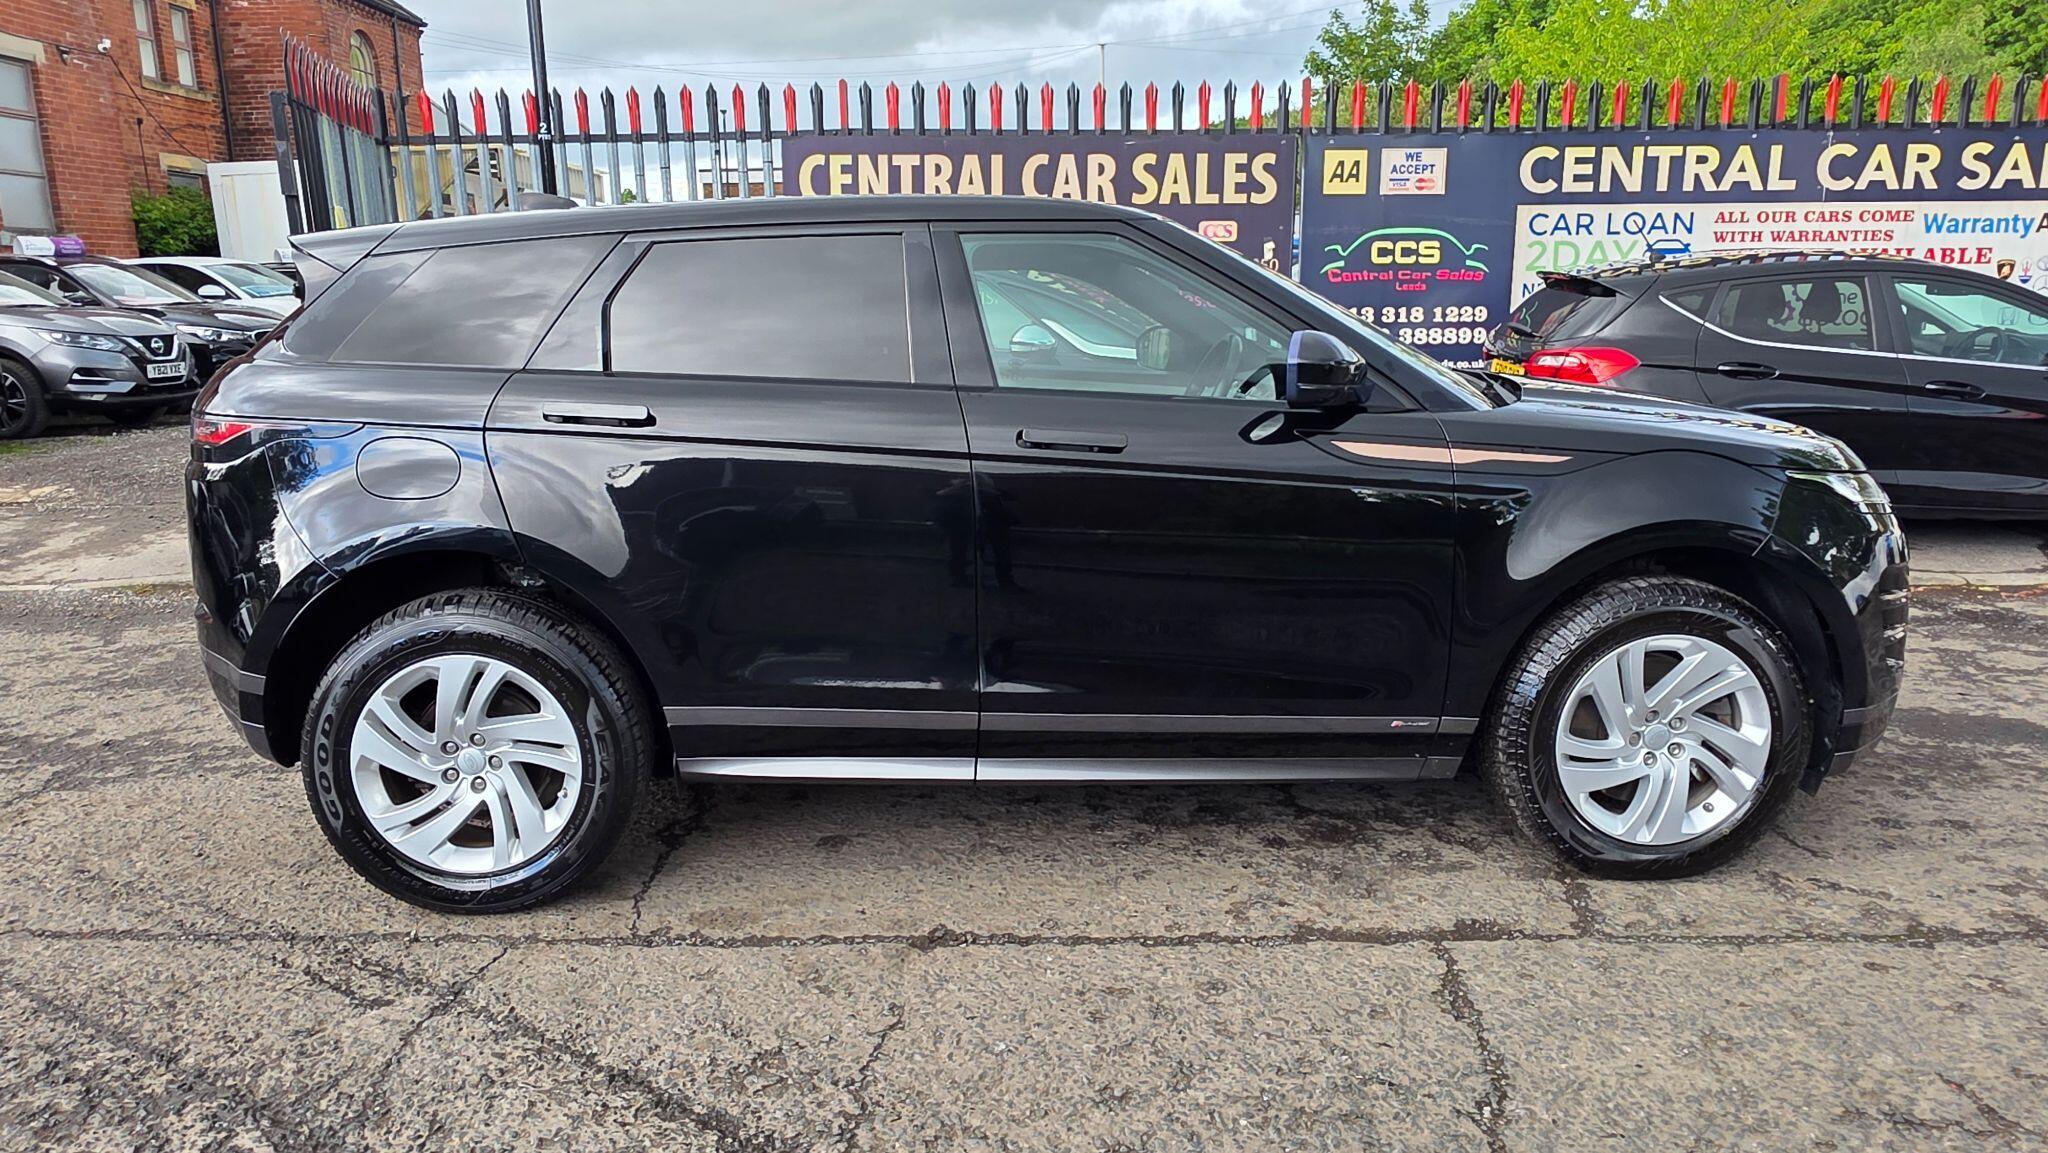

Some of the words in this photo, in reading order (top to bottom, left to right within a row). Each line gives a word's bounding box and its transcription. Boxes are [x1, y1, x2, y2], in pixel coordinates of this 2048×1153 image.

[540, 122, 548, 134] 2
[1405, 152, 1422, 162] WE
[1329, 160, 1361, 183] AA
[1390, 164, 1436, 175] ACCEPT
[1519, 145, 1797, 194] CENTRAL
[1816, 143, 1942, 191] CAR
[799, 153, 1004, 196] CENTRAL
[1021, 152, 1117, 204] CAR
[1131, 152, 1278, 205] SALES
[1528, 213, 1594, 236] CAR
[1606, 212, 1694, 236] LOAN
[1714, 211, 1750, 223] ALL
[1756, 211, 1797, 223] OUR
[1803, 210, 1853, 222] CARS
[1858, 210, 1915, 222] COME
[1203, 224, 1233, 239] CCS
[1713, 231, 1764, 243] WITH
[1770, 230, 1895, 242] WARRANTIES
[1370, 240, 1441, 265] CCS
[1327, 268, 1394, 283] Central
[1398, 270, 1432, 280] Car
[1435, 269, 1485, 281] Sales
[1395, 282, 1427, 291] Leeds
[1348, 306, 1375, 322] 13
[1381, 306, 1425, 323] 318
[1432, 306, 1488, 323] 1229
[1398, 327, 1487, 345] 388899
